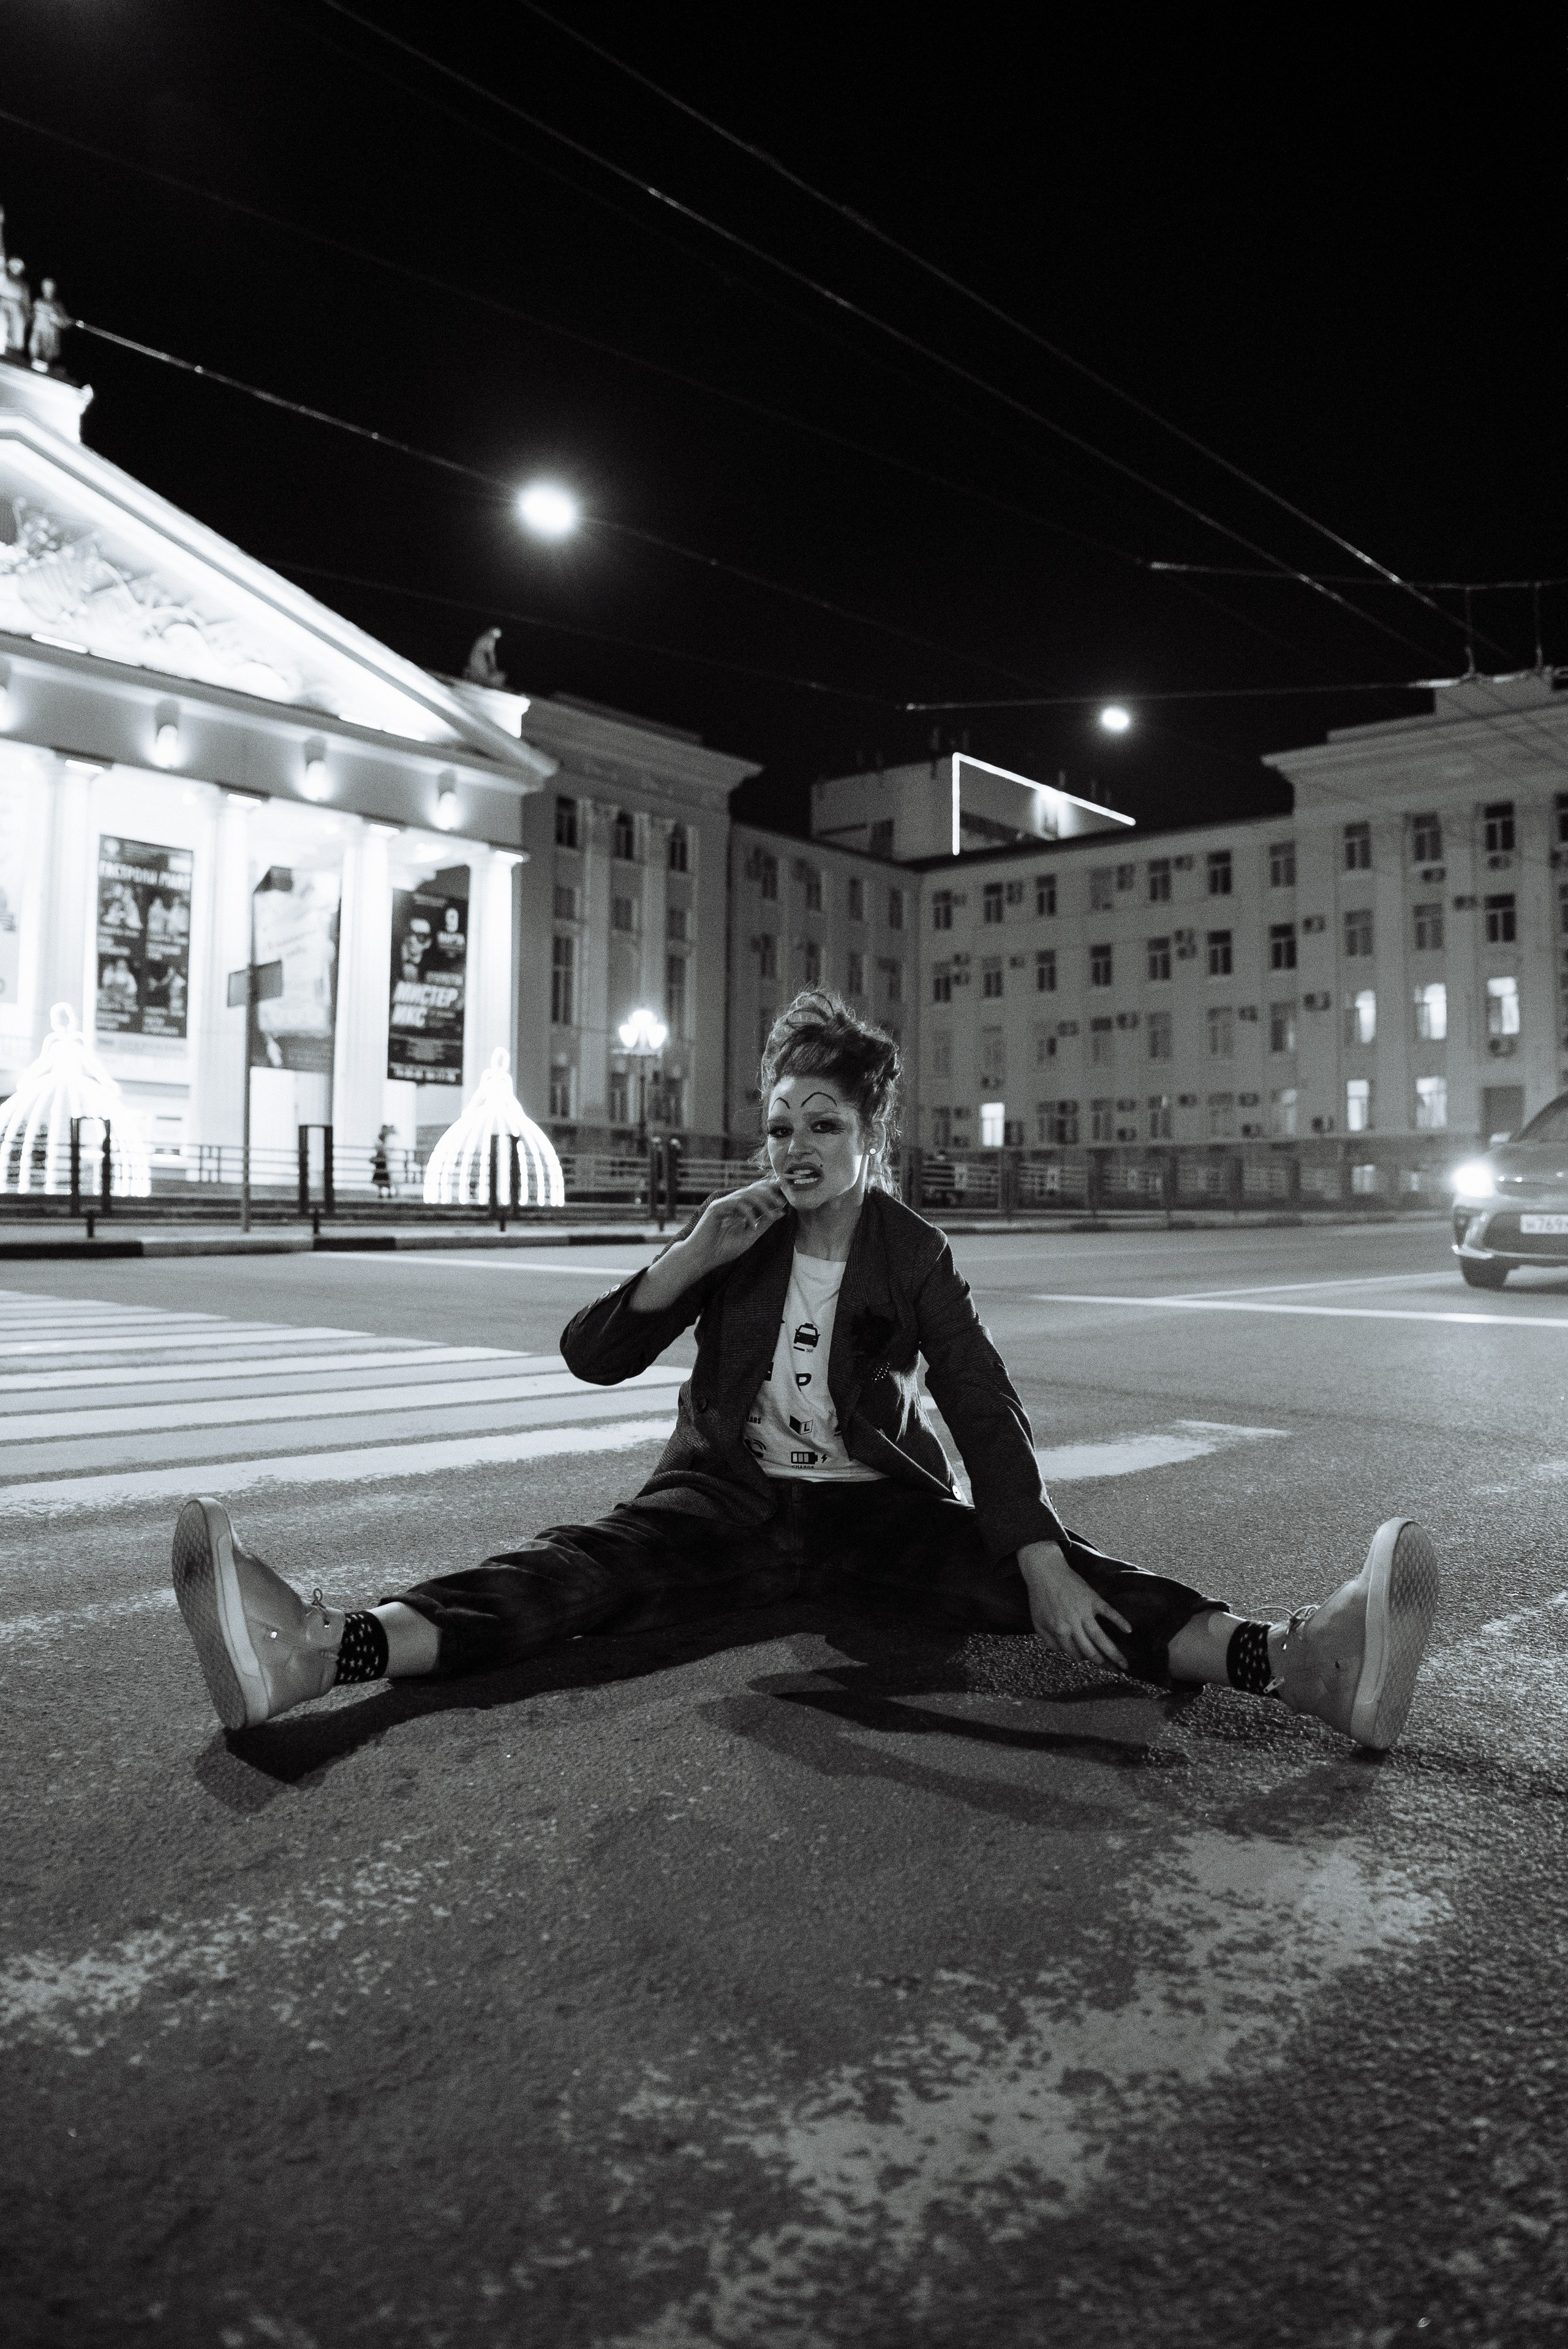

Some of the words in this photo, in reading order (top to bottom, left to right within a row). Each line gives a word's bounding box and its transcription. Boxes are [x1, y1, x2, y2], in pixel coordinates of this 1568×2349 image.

[445, 908, 459, 932] 9
[393, 981, 459, 1008] МИСТЕР
[392, 1003, 428, 1028] ИКС
[795, 1373, 812, 1392] P
[804, 1423, 810, 1432] L
